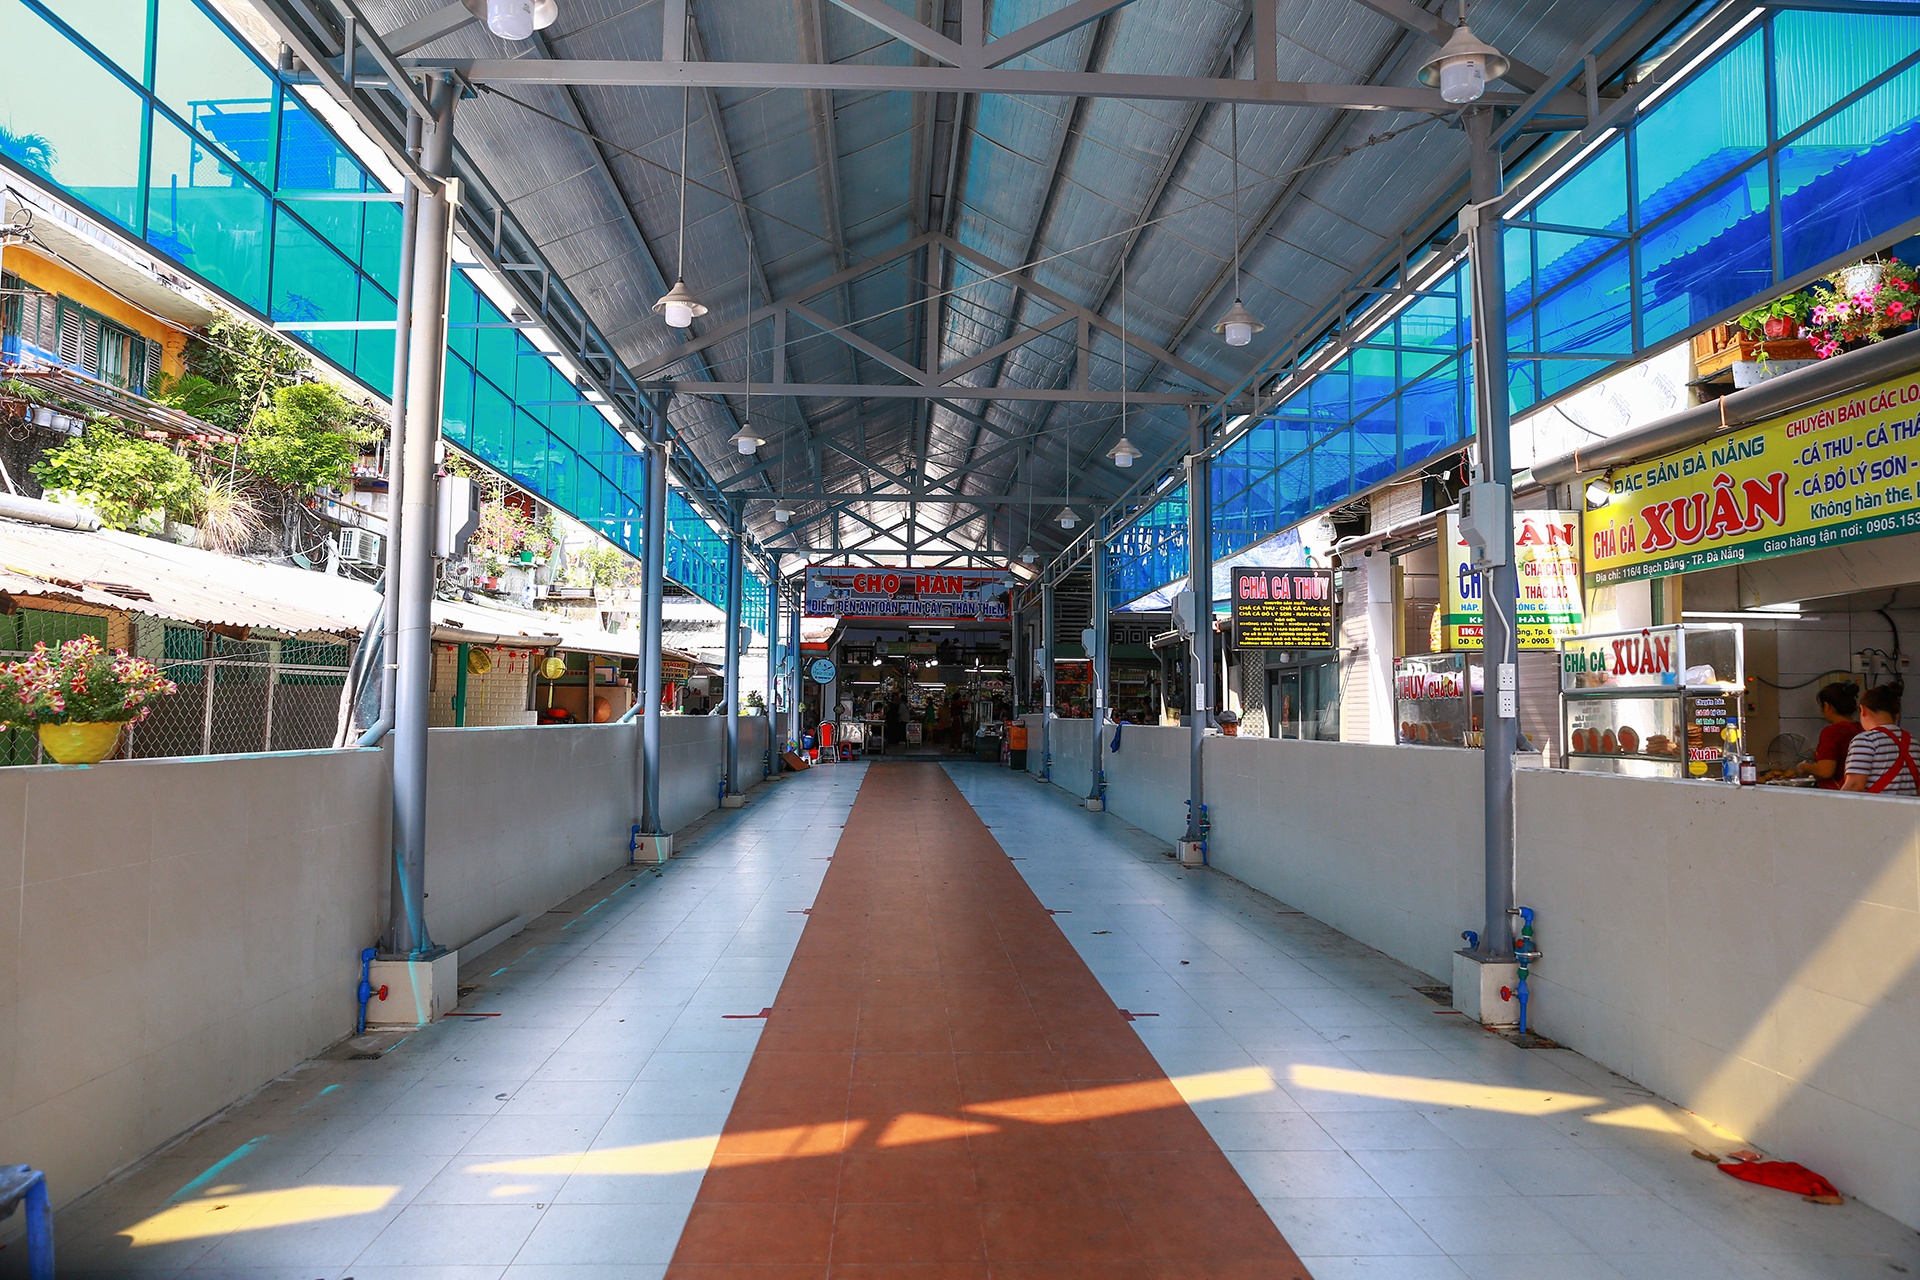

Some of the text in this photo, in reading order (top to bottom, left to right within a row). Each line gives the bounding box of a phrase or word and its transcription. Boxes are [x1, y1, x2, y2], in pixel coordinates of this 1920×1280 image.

[1786, 383, 1920, 438] CHUYÊN BÁN CÁC LO
[1801, 441, 1821, 466] CÁ
[1823, 435, 1853, 460] THU
[1866, 422, 1889, 448] CÁ
[1614, 436, 1765, 496] ĐẶC SẢN ĐÀ NẴNG
[1802, 473, 1822, 497] CÁ
[1824, 465, 1846, 493] ĐỎ
[1850, 460, 1868, 486] LÝ
[1871, 455, 1907, 481] SƠN
[1593, 471, 1789, 560] CHẢ CÁ XUÂN
[1810, 500, 1852, 521] Không
[1855, 491, 1882, 511] hàn
[1885, 486, 1913, 503] the,
[1763, 540, 1787, 552] Giao
[1789, 533, 1816, 547] hàng
[1819, 528, 1837, 544] tận
[1841, 523, 1863, 538] nơi:
[1595, 572, 1608, 583] Địa
[1622, 566, 1642, 578] 116/4
[1643, 560, 1662, 576] Bạch
[1691, 554, 1705, 565] TP.
[1707, 551, 1719, 563] Đà
[853, 571, 963, 598] CHỢ HÀN
[1240, 571, 1329, 599] CHẢ CÁ THỦY
[859, 601, 873, 613] AN
[875, 598, 898, 613] TOÀN
[907, 601, 921, 613] TIN
[1519, 615, 1545, 623] HÀN
[1564, 628, 1671, 675] CHẢ CÁ XUÂN
[1429, 675, 1445, 698] CHẢ
[1447, 674, 1459, 697] CÁ
[1690, 747, 1718, 760] Xuân
